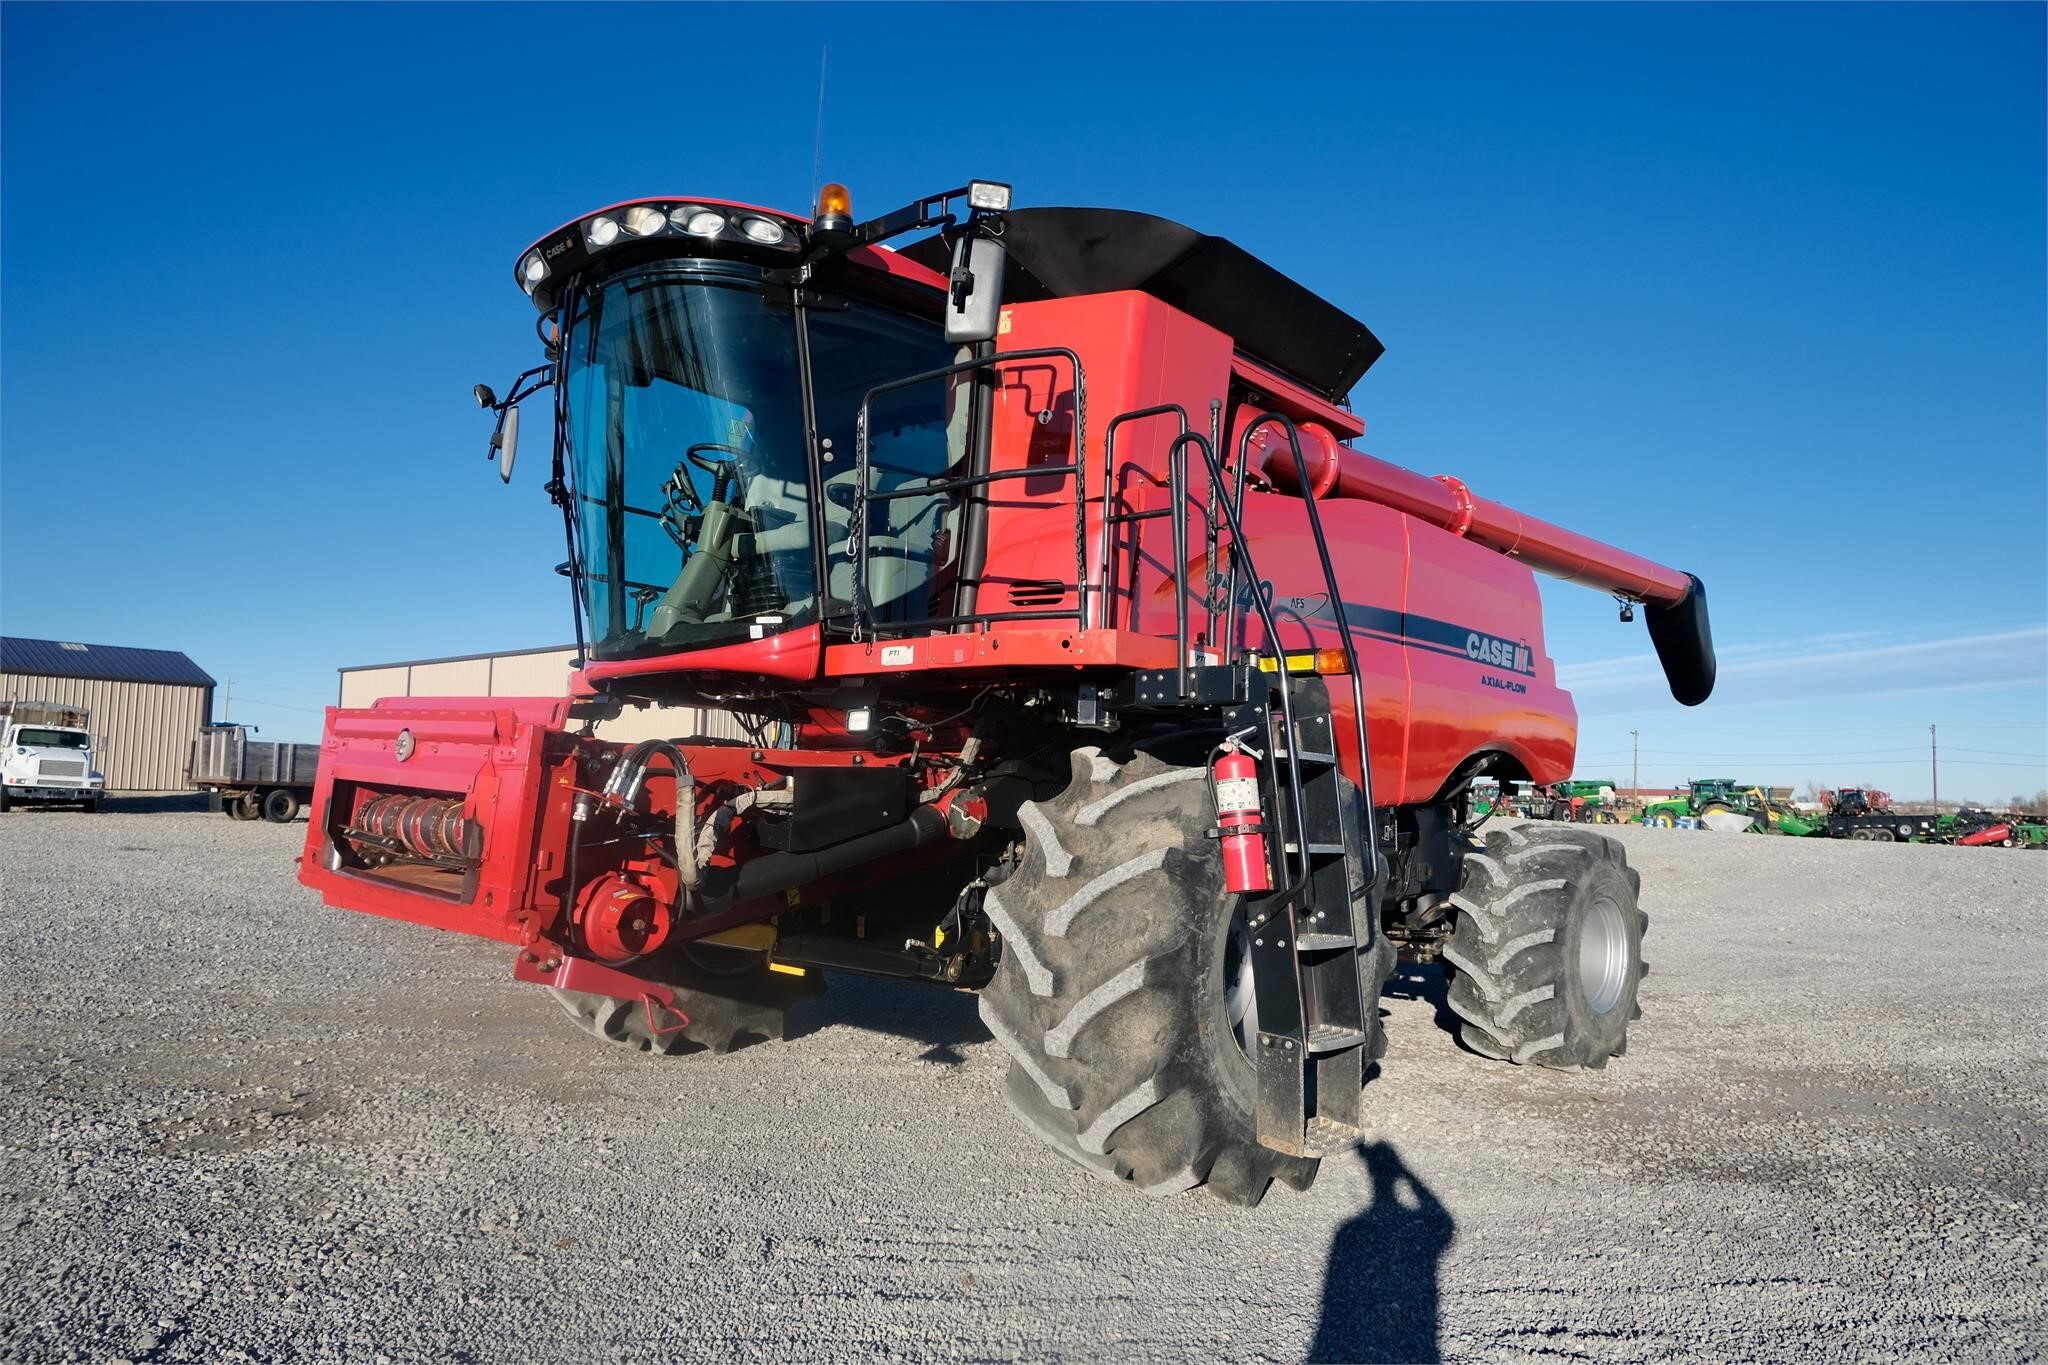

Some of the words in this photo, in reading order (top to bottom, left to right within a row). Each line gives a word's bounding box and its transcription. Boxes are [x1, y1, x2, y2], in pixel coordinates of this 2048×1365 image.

[546, 242, 566, 260] CASE
[1290, 597, 1305, 609] AFS
[889, 649, 901, 657] PTI
[1466, 632, 1513, 669] CASE
[1481, 674, 1527, 695] AXIAL-FLOW
